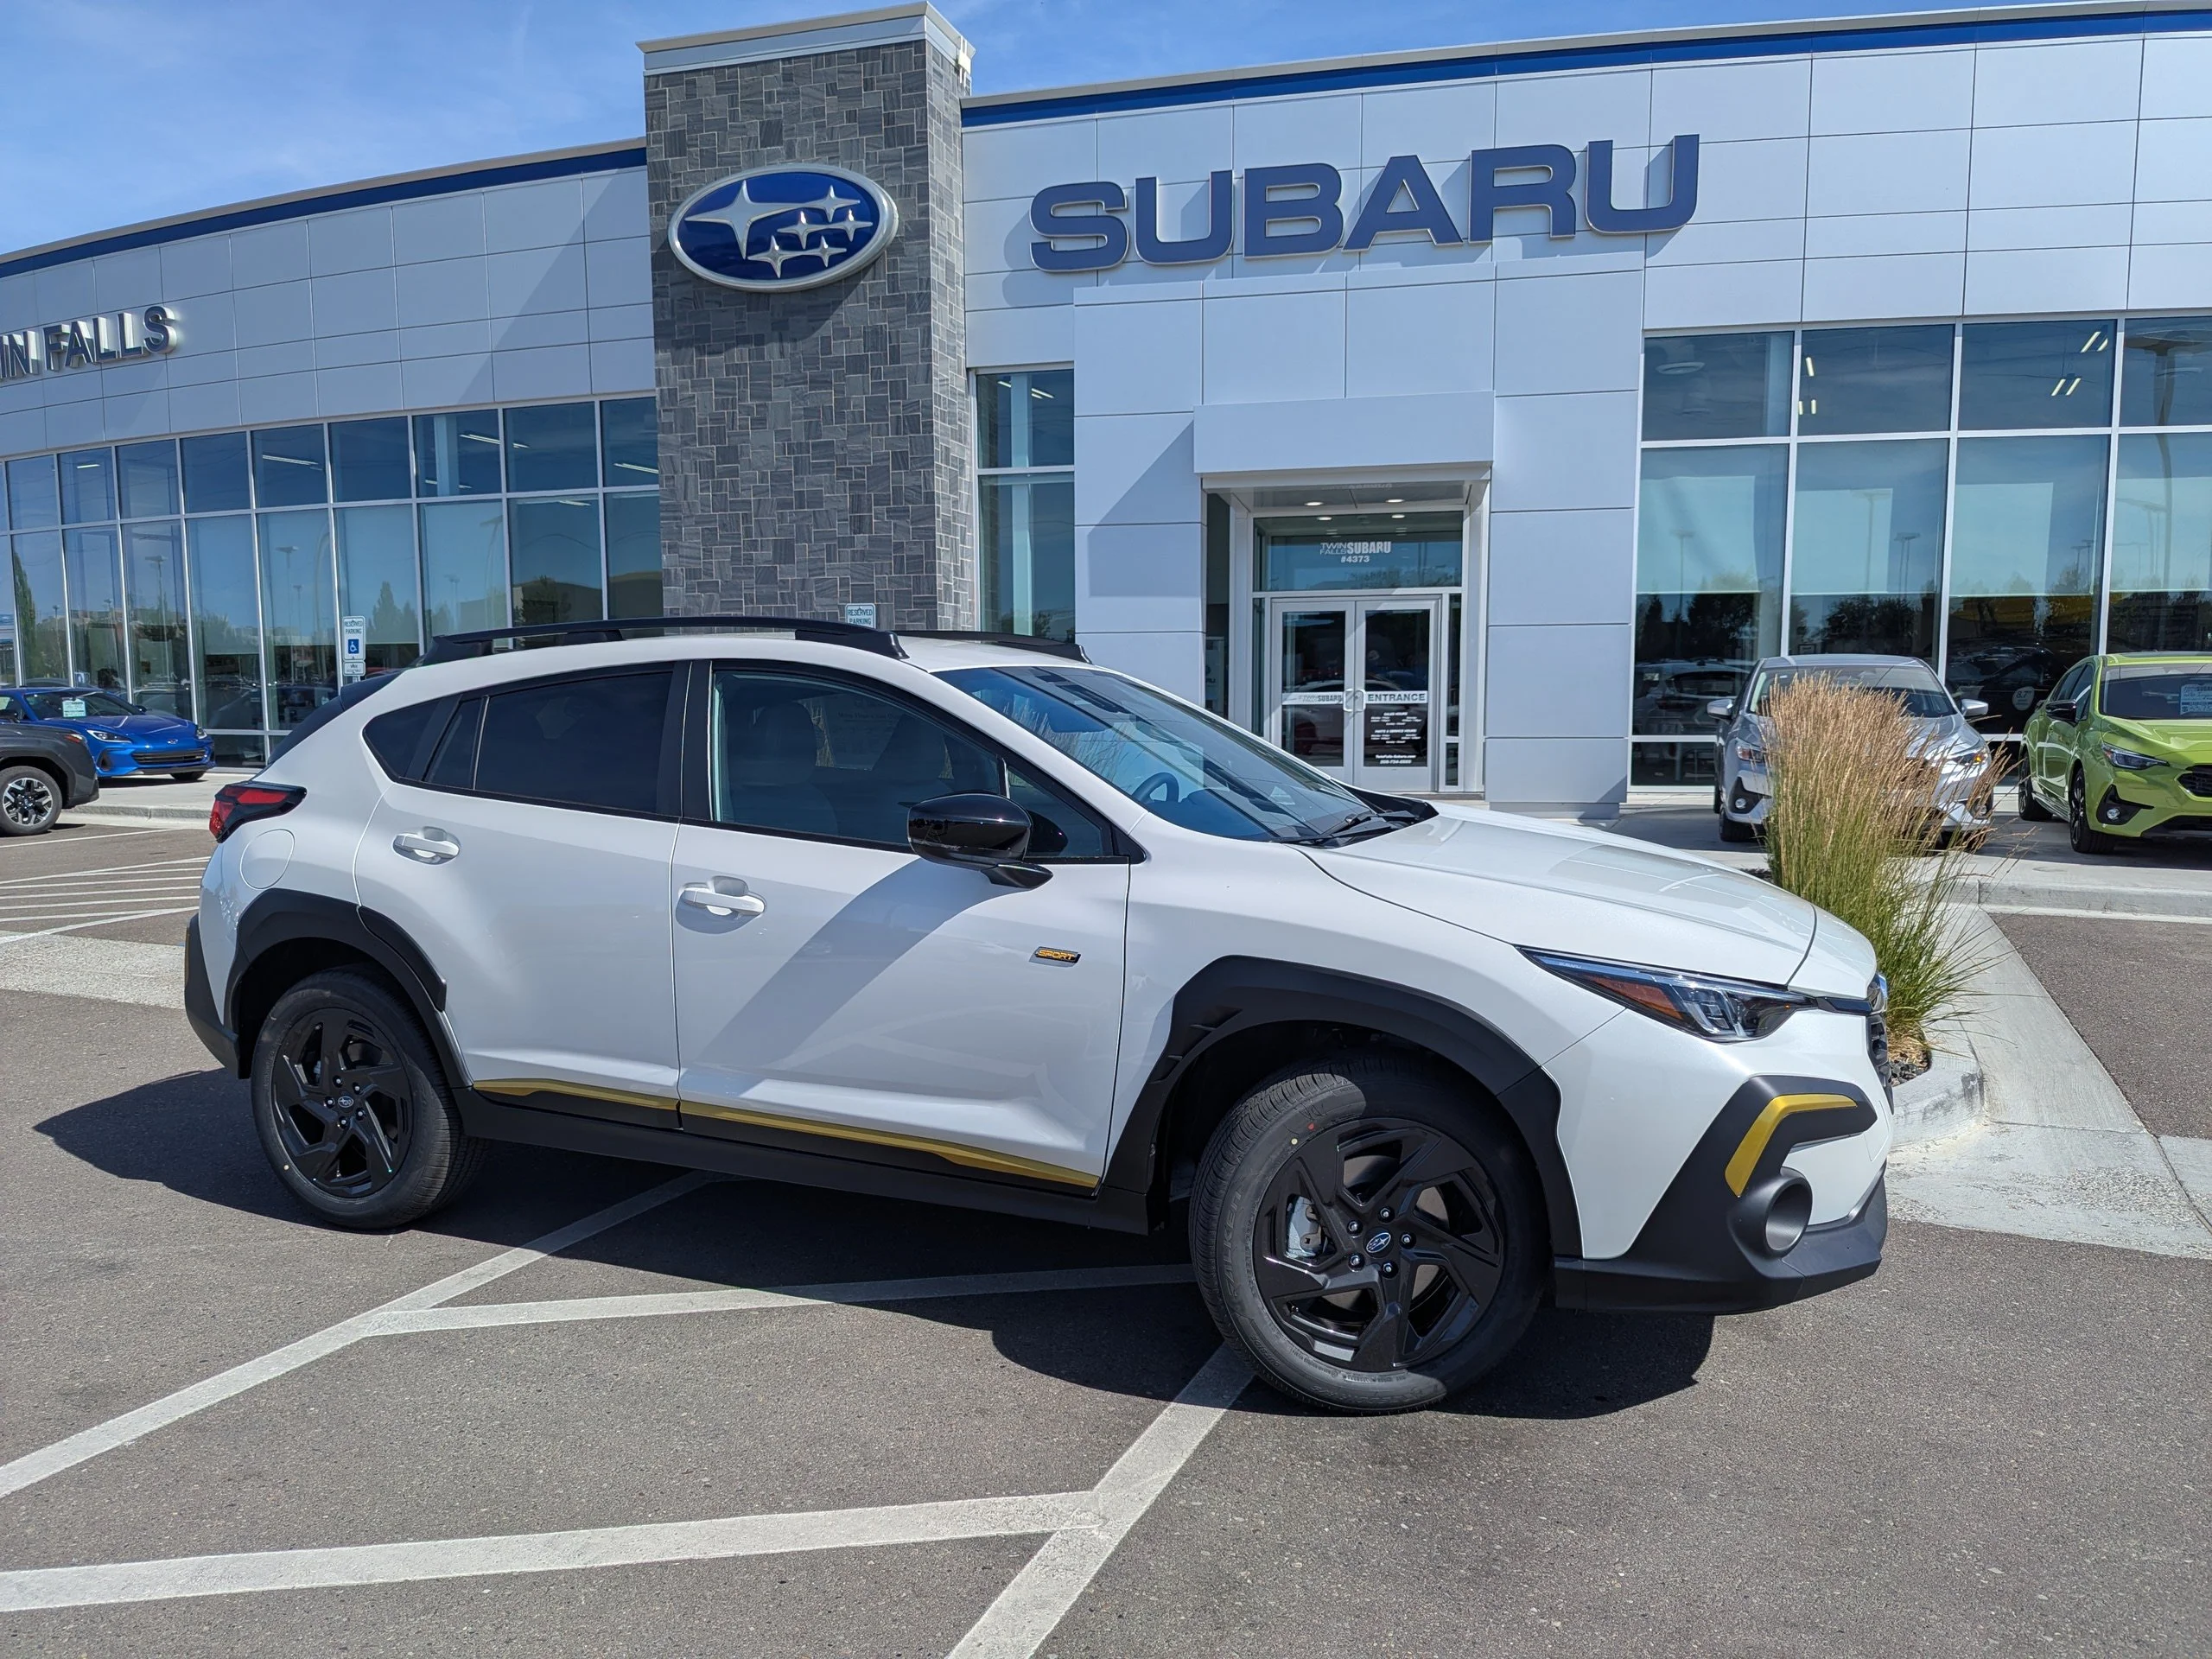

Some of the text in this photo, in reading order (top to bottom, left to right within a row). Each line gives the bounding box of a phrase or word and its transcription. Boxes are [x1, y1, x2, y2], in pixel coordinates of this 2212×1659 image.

[1030, 134, 1700, 275] SUBARU
[43, 306, 177, 371] FALLS
[1347, 542, 1391, 554] SUBARU
[1368, 693, 1426, 702] ENTRANCE
[1038, 950, 1074, 960] SPORT
